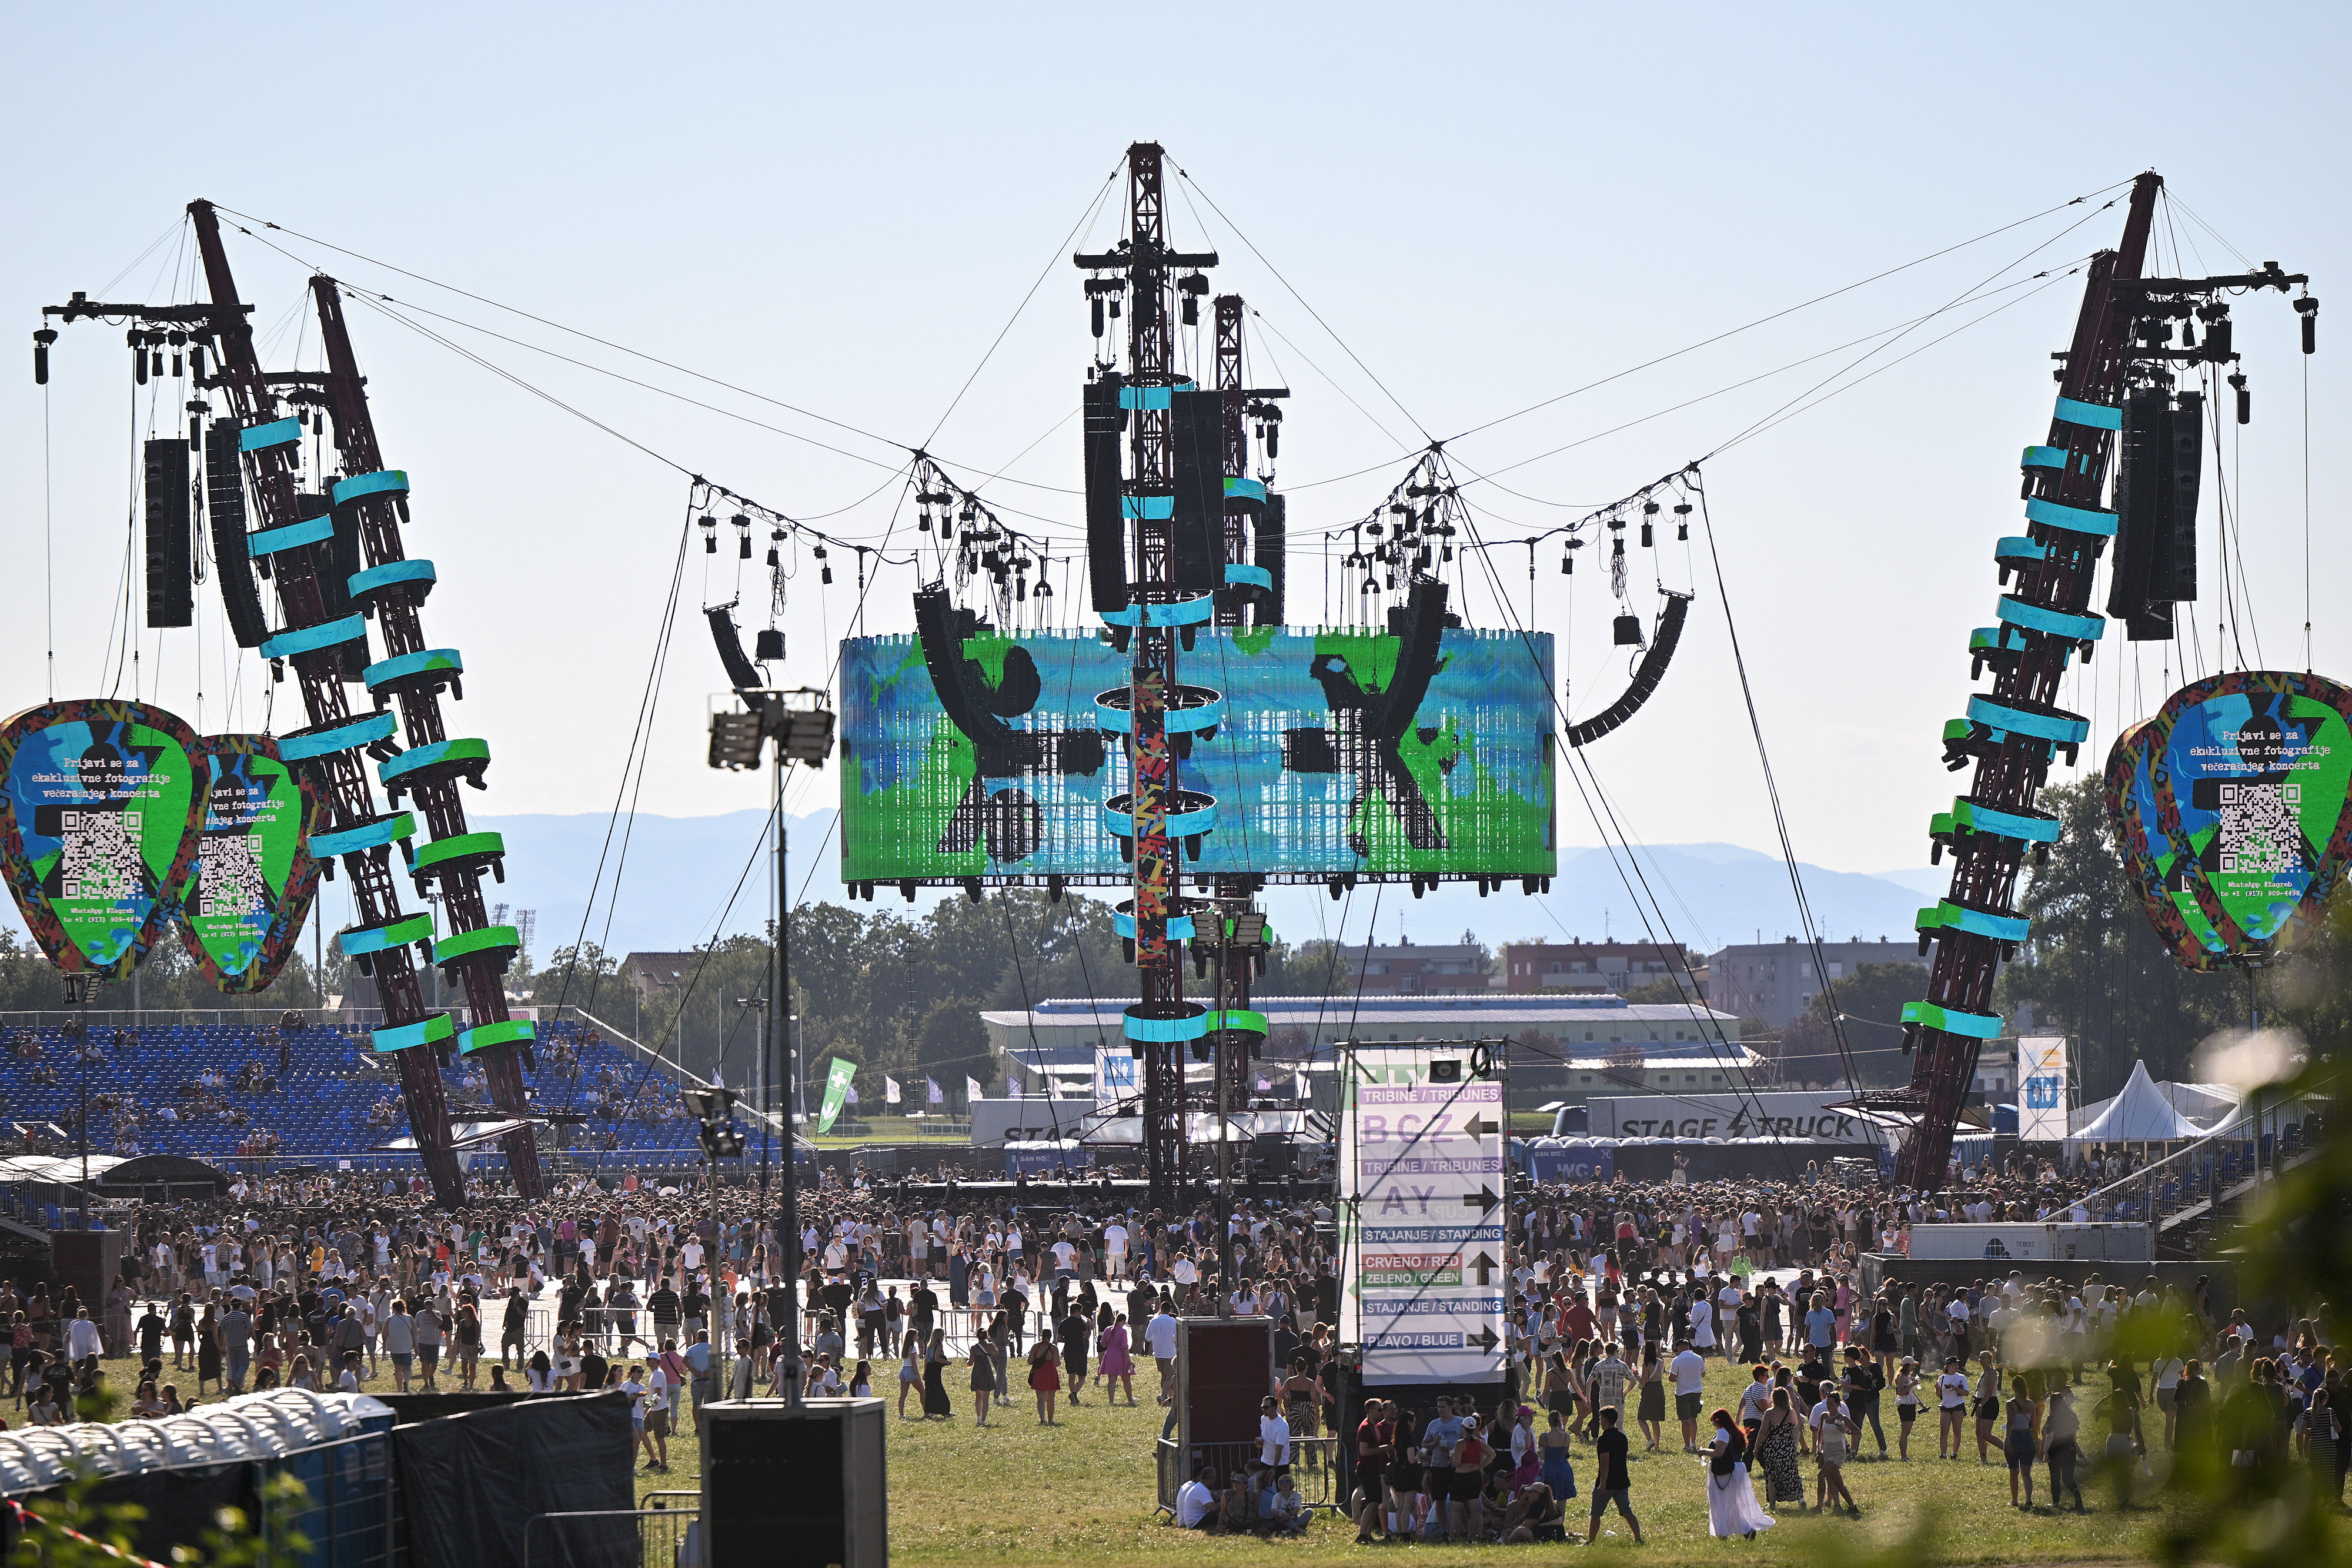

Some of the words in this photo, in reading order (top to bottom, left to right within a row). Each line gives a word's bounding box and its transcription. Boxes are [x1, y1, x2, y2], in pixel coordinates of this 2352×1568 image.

[2221, 730, 2265, 742] Prijavi
[2269, 731, 2281, 740] se
[2286, 731, 2298, 740] za
[2190, 745, 2260, 755] ekskluzivne
[2264, 745, 2330, 757] fotografije
[64, 758, 106, 770] Prijavi
[110, 760, 122, 768] se
[126, 760, 139, 768] za
[2201, 761, 2264, 773] večerašnjeg
[2269, 760, 2320, 770] koncerta
[32, 773, 101, 783] ekskluzivne
[105, 773, 171, 784] fotografije
[42, 789, 106, 800] večerašnjeg
[109, 788, 161, 798] koncerta
[211, 788, 233, 798] ijavi
[232, 800, 284, 811] fotografije
[236, 814, 276, 823] koncerta
[1364, 1090, 1418, 1102] TRIBINE
[1429, 1089, 1499, 1101] TRIBUNES
[1621, 1119, 1718, 1139] STAGE
[1757, 1115, 1854, 1138] TRUCK
[1365, 1161, 1418, 1174] TRIBINE
[1431, 1159, 1500, 1172] TRIBUNES
[1557, 1163, 1588, 1178] WC
[1380, 1185, 1435, 1215] AY
[1365, 1230, 1428, 1241] STAJANJE
[1439, 1228, 1501, 1239] STANDING
[1365, 1256, 1421, 1268] CRVENO
[1432, 1255, 1459, 1267] RED
[861, 1277, 867, 1288] 2
[1366, 1273, 1411, 1284] ZELENO
[1420, 1272, 1459, 1283] GREEN
[1367, 1302, 1429, 1313] STAJANJE
[1439, 1300, 1501, 1312] STANDING
[1368, 1335, 1411, 1347] PLAVO
[1422, 1334, 1458, 1346] BLUE
